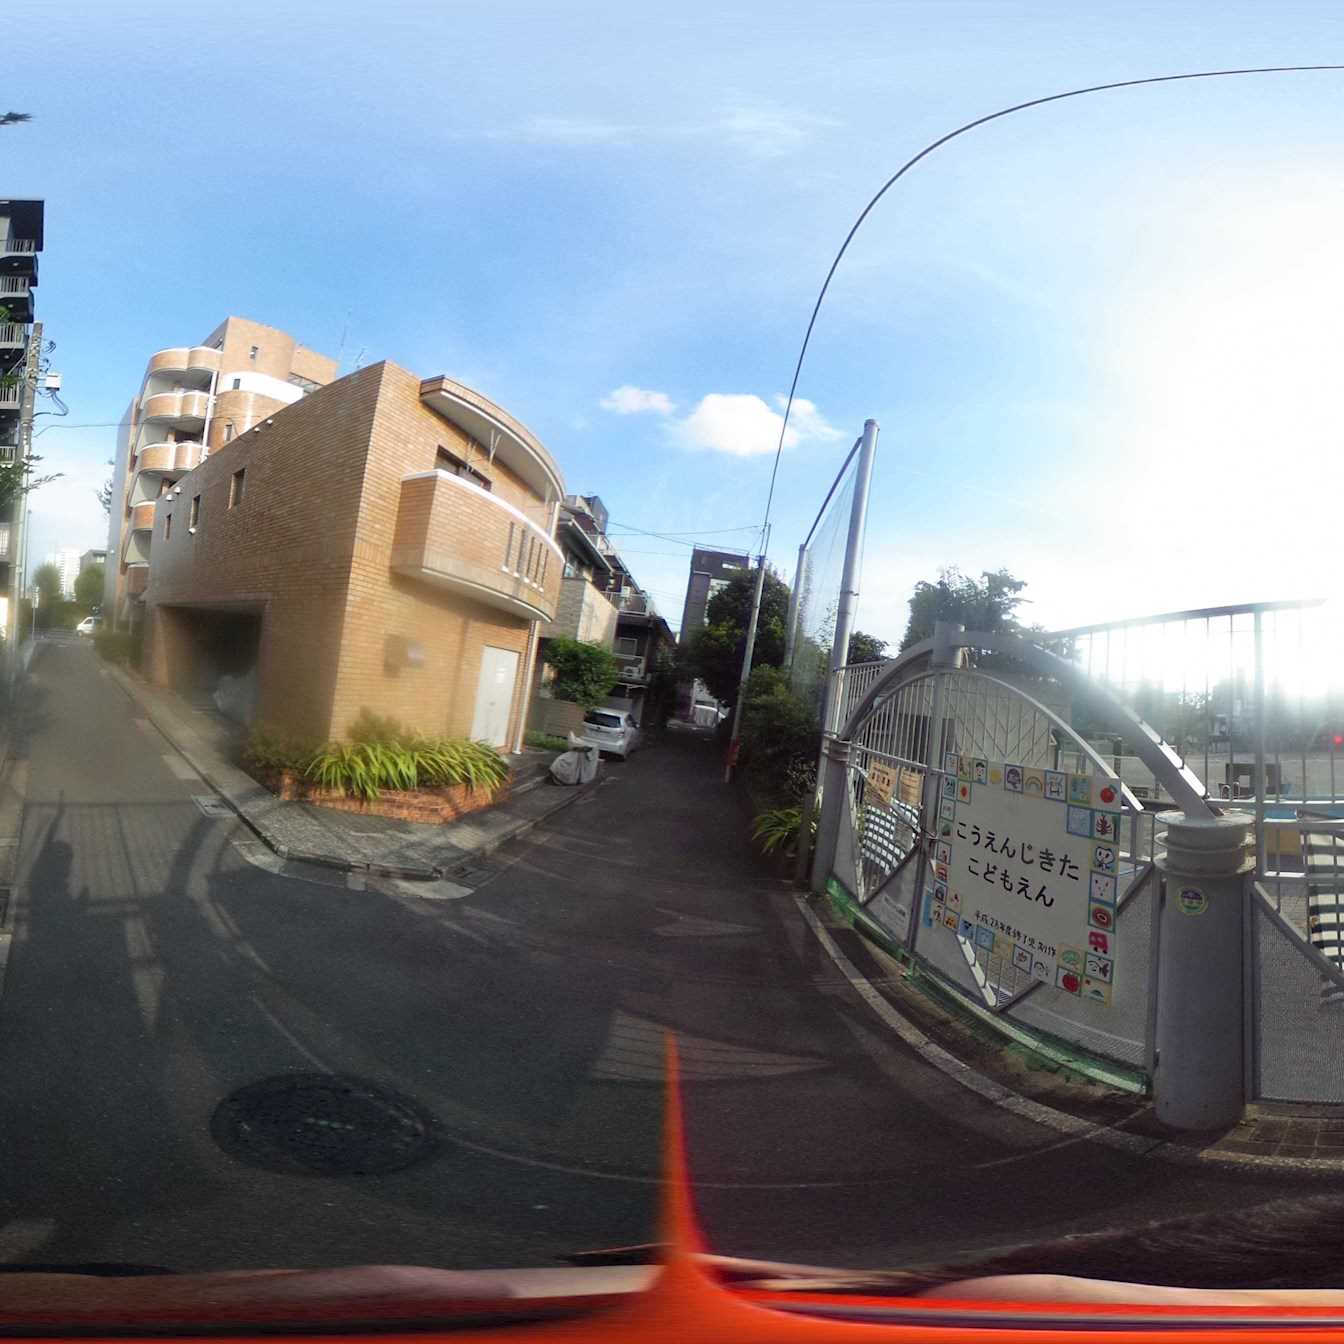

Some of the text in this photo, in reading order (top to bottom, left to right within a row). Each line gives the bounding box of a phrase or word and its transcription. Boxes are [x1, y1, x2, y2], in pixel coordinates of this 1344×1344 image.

[957, 821, 1080, 881] こうえんじきた
[968, 857, 1055, 908] こどもえん
